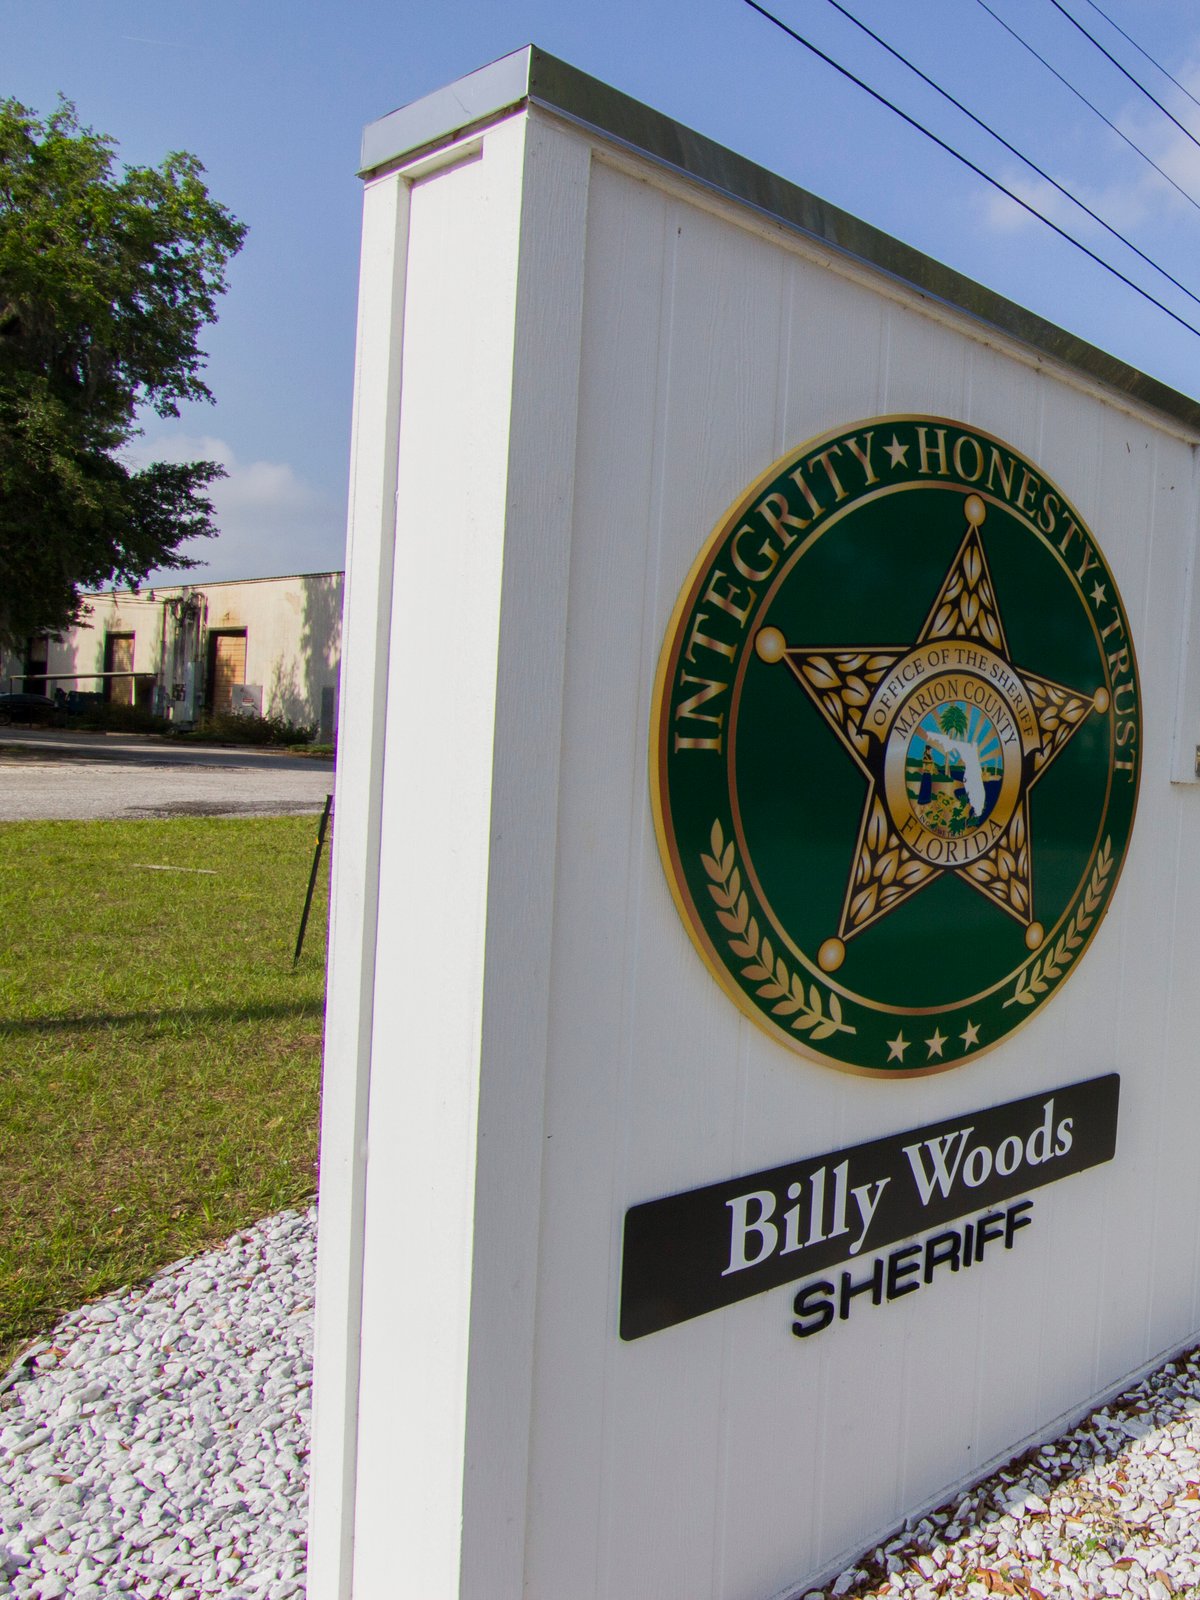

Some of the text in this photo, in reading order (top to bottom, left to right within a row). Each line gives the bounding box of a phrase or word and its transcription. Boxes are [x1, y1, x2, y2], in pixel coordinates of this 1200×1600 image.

[674, 427, 1137, 784] INTEGRITY HONESTY TRUST
[873, 648, 1034, 737] OFFICE OF THE SHERIFF
[893, 679, 1018, 746] MARION COUNTY
[899, 812, 1004, 864] FLORIDA
[721, 1097, 1074, 1278] Billy Woods
[792, 1200, 1035, 1339] SHERIFF
